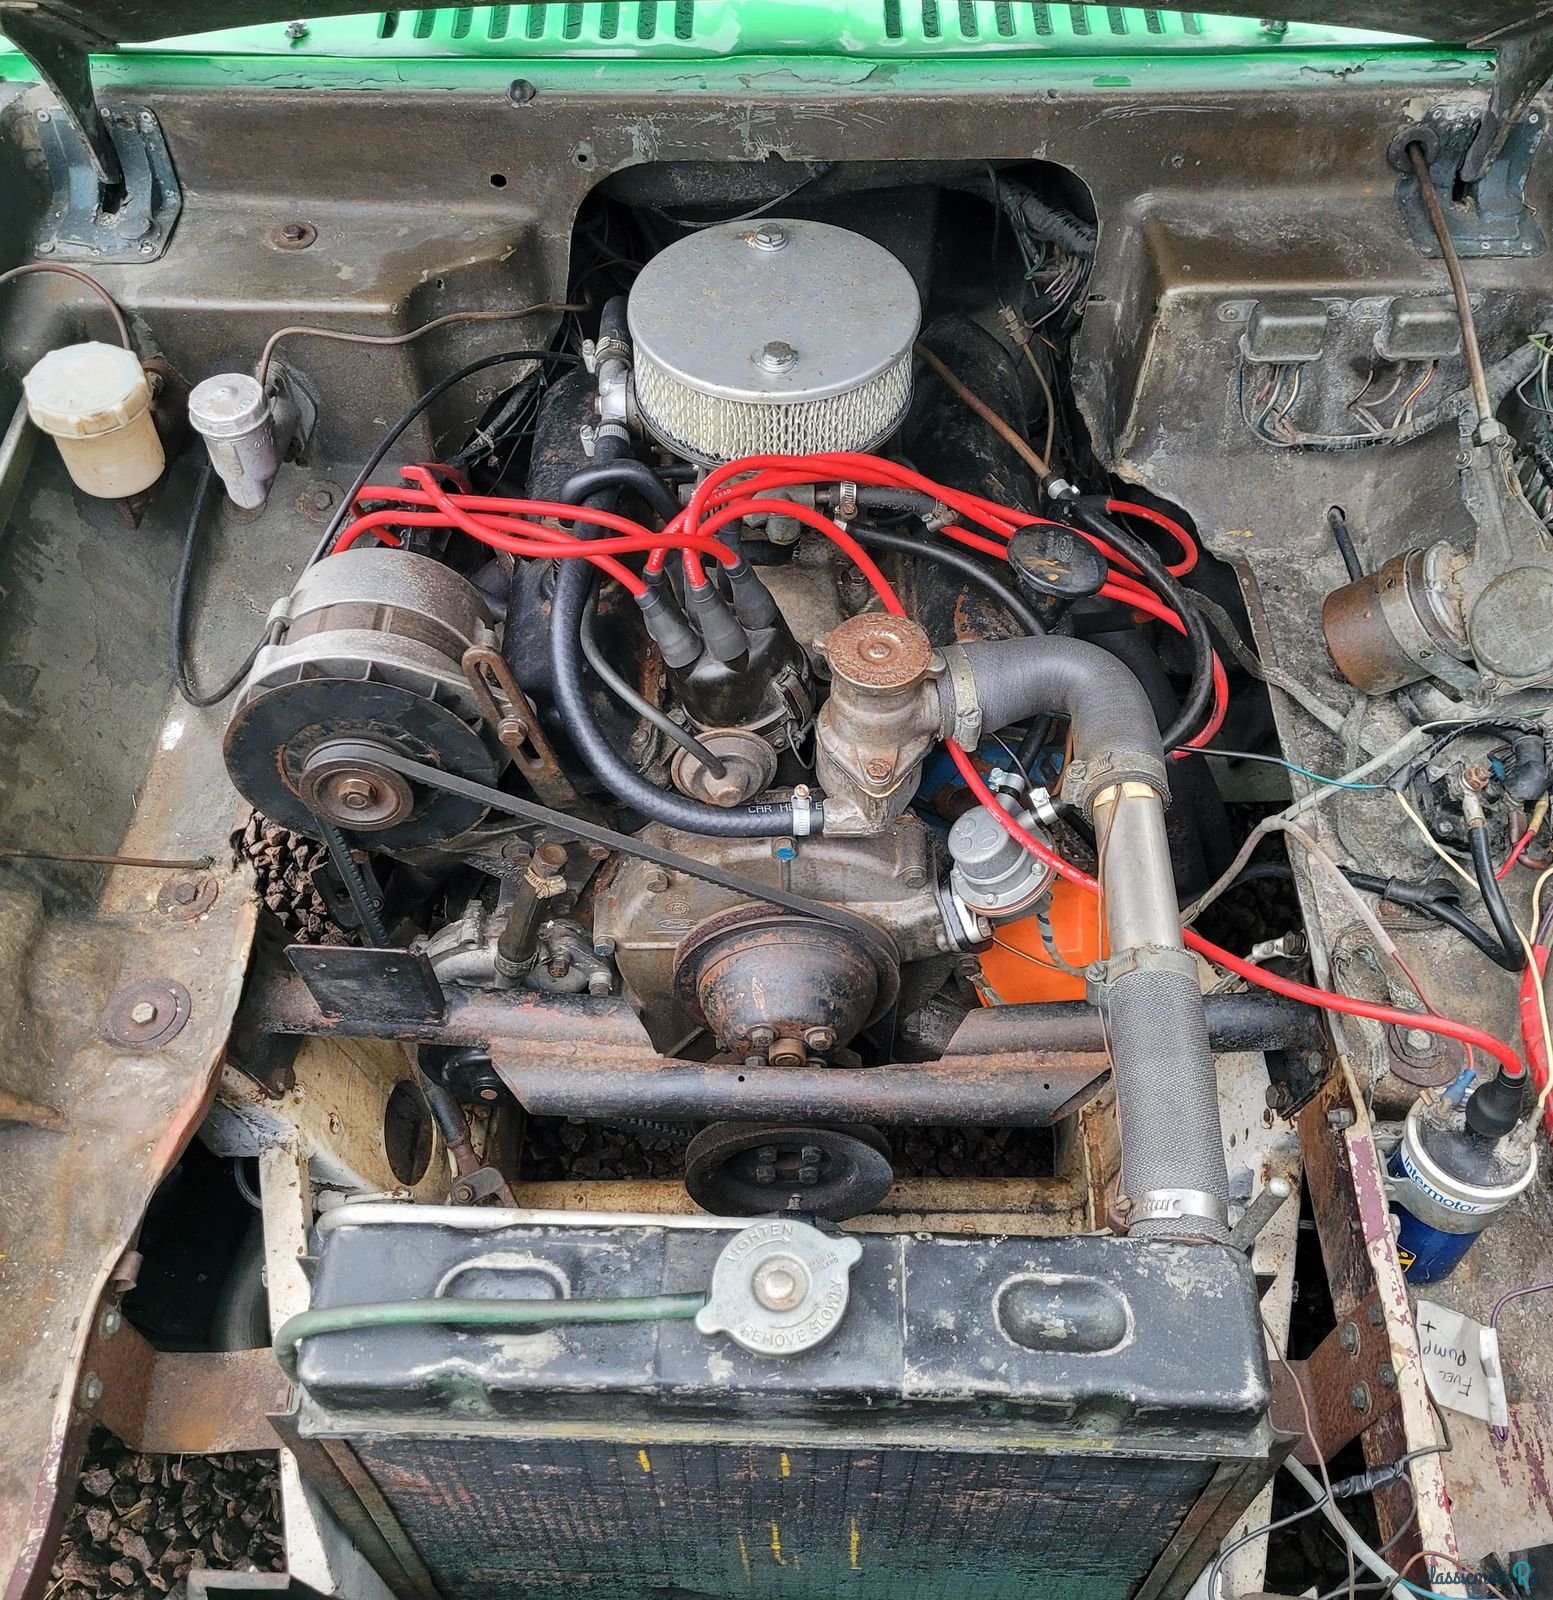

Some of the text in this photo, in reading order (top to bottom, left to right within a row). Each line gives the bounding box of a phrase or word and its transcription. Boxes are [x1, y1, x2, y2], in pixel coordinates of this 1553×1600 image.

[747, 804, 773, 814] CAR
[1403, 1155, 1479, 1213] Intermotor
[724, 1223, 794, 1263] TIGHTEN
[740, 1279, 843, 1347] REMOVE SLOWLY
